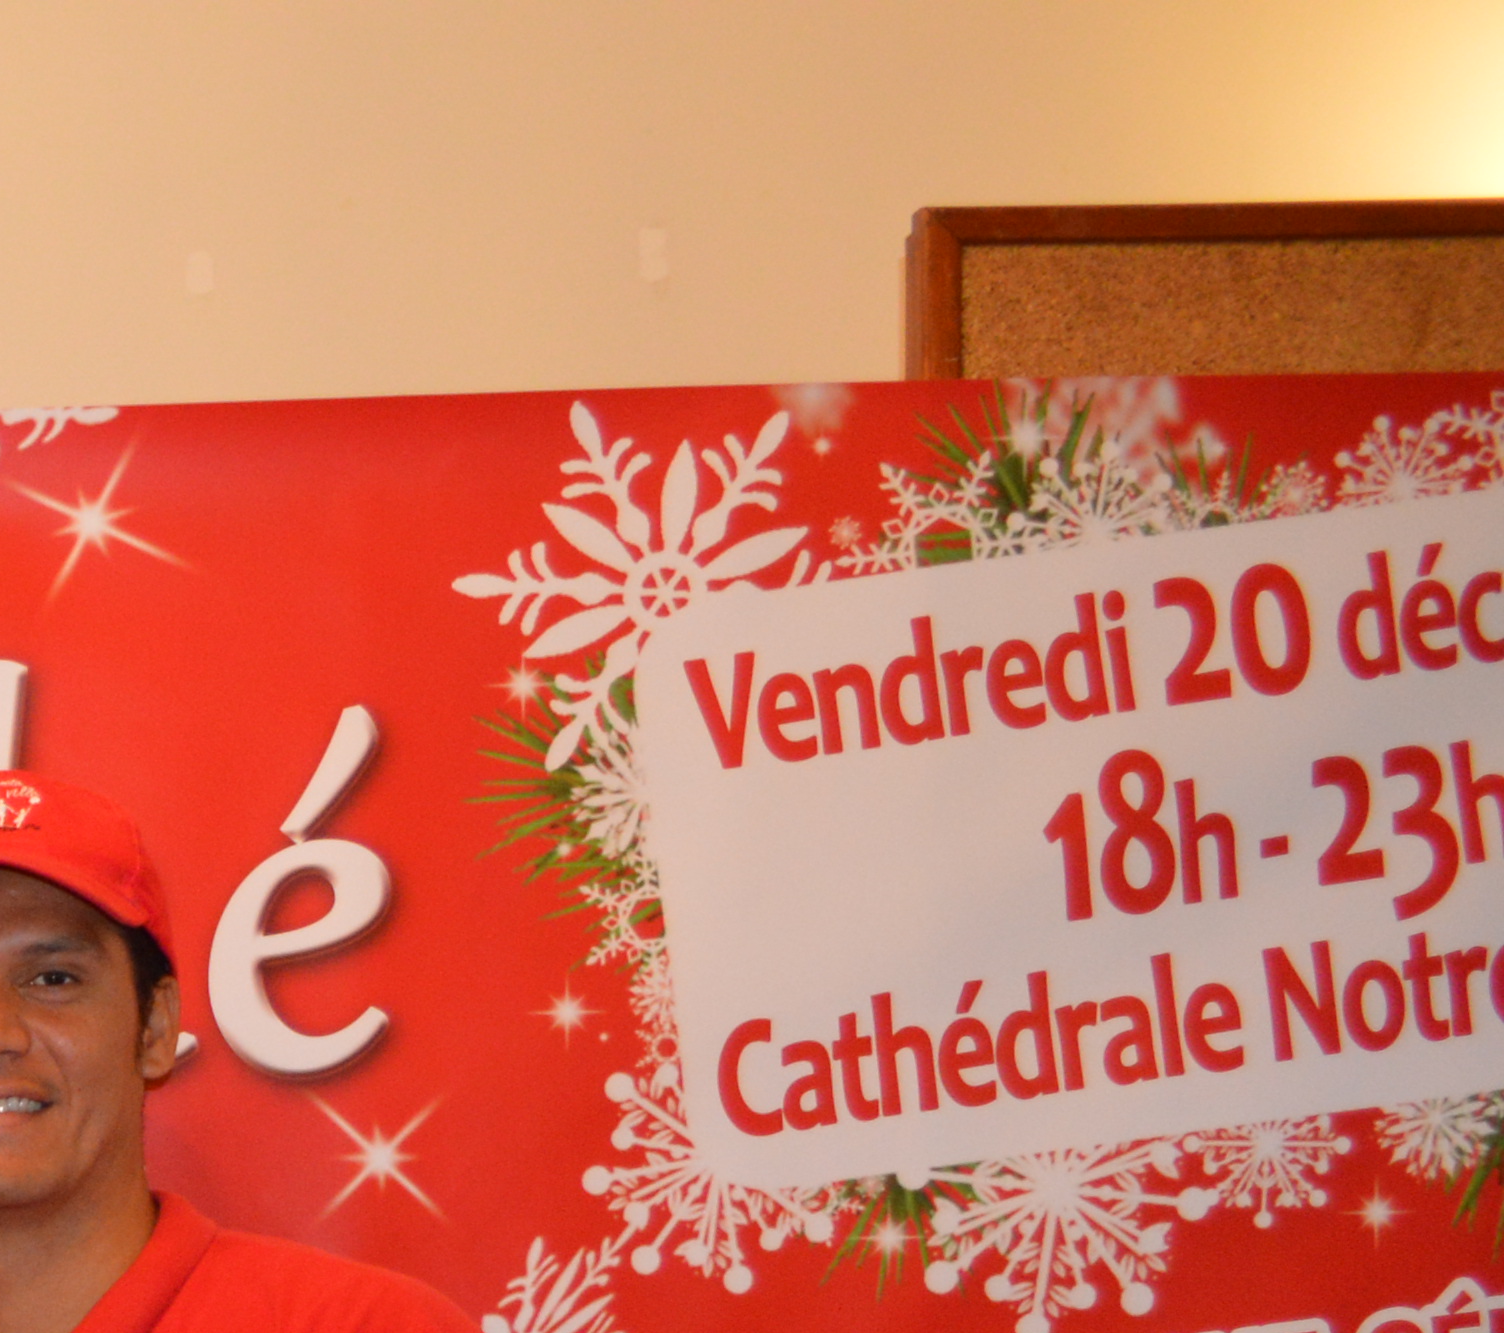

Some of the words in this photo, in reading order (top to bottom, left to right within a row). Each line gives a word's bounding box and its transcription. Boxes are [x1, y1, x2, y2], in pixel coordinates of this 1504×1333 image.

[683, 589, 1137, 770] Vendredi
[1153, 562, 1311, 705] 20
[1044, 749, 1239, 921] 18h
[1259, 833, 1290, 858] -
[717, 954, 1244, 1137] Cathédrale
[1263, 931, 1504, 1061] Notr
